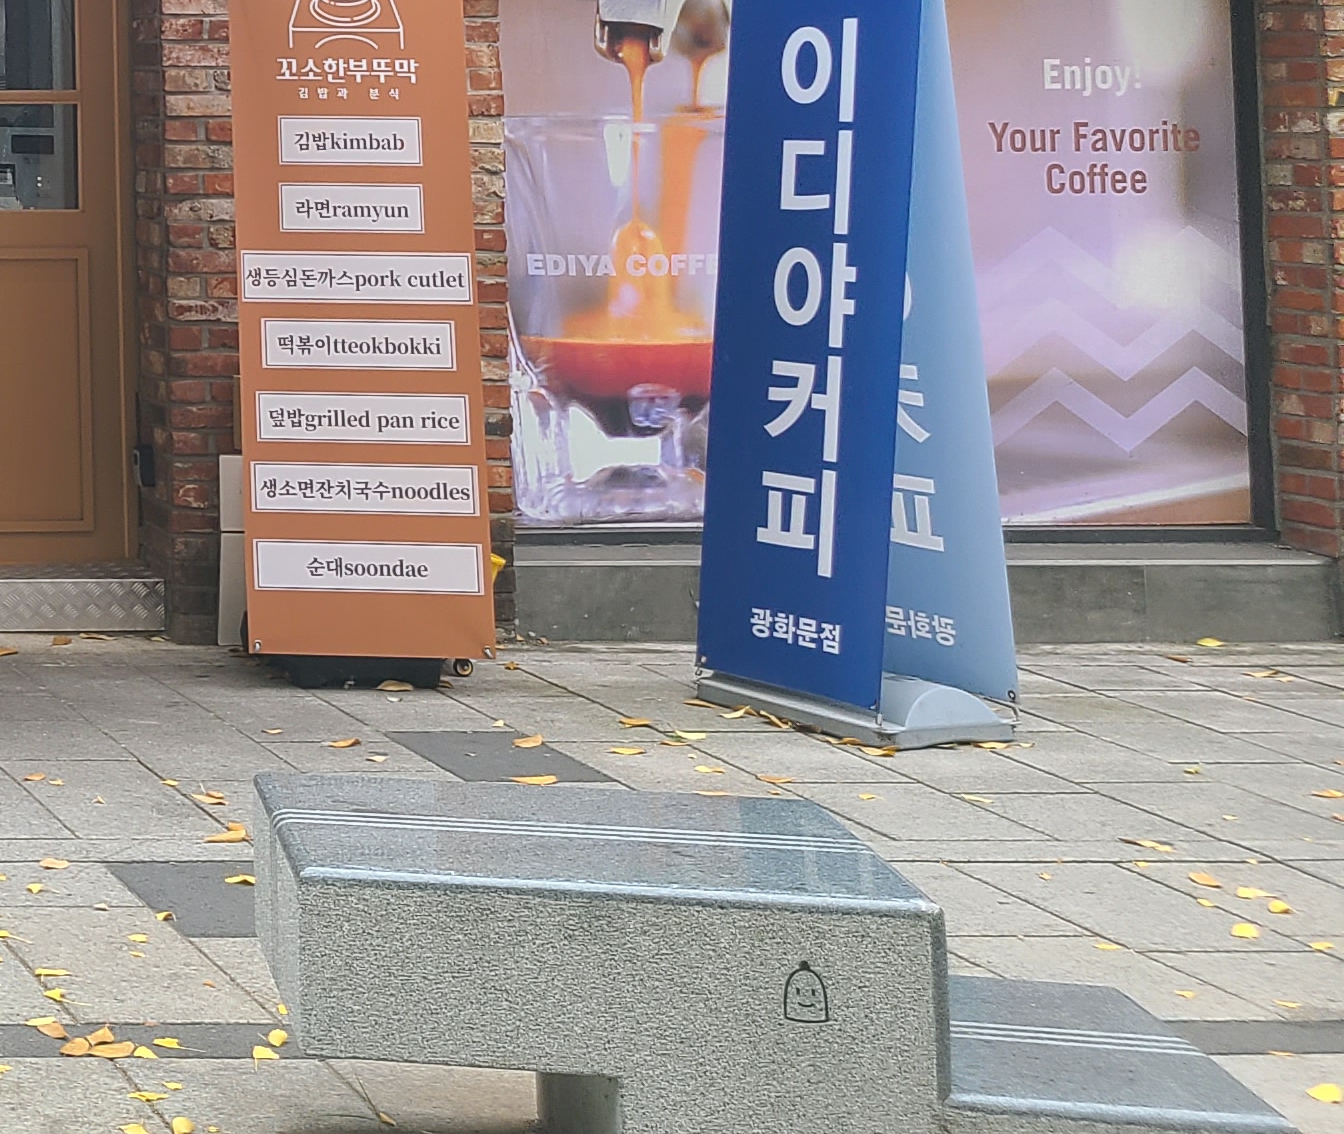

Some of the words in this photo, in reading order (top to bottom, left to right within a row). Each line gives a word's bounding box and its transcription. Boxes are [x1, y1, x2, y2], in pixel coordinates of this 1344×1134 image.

[275, 58, 419, 84] 꼬소한부뚜막
[1043, 57, 1142, 97] Enjoy!
[298, 86, 349, 100] 김밥과
[369, 86, 400, 100] 분식
[293, 131, 406, 153] 김밥kimbab
[988, 122, 1061, 153] Your
[1073, 120, 1201, 153] Favorite
[1046, 163, 1148, 194] Coffee
[295, 198, 410, 223] 라면ramyun
[526, 253, 617, 277] EDIYA
[245, 267, 402, 292] 생등심돈까스pork
[407, 270, 465, 289] cutlet
[756, 16, 859, 579] 이디야커피
[277, 333, 442, 357] 떡볶이tteokbokki
[268, 407, 371, 432] 덮밥grilled
[376, 414, 415, 433] pan
[420, 412, 461, 431] rice
[260, 478, 472, 502] 생소면잔치국수noodles
[306, 556, 429, 579] 순대soondae
[750, 607, 841, 655] 광화문점
